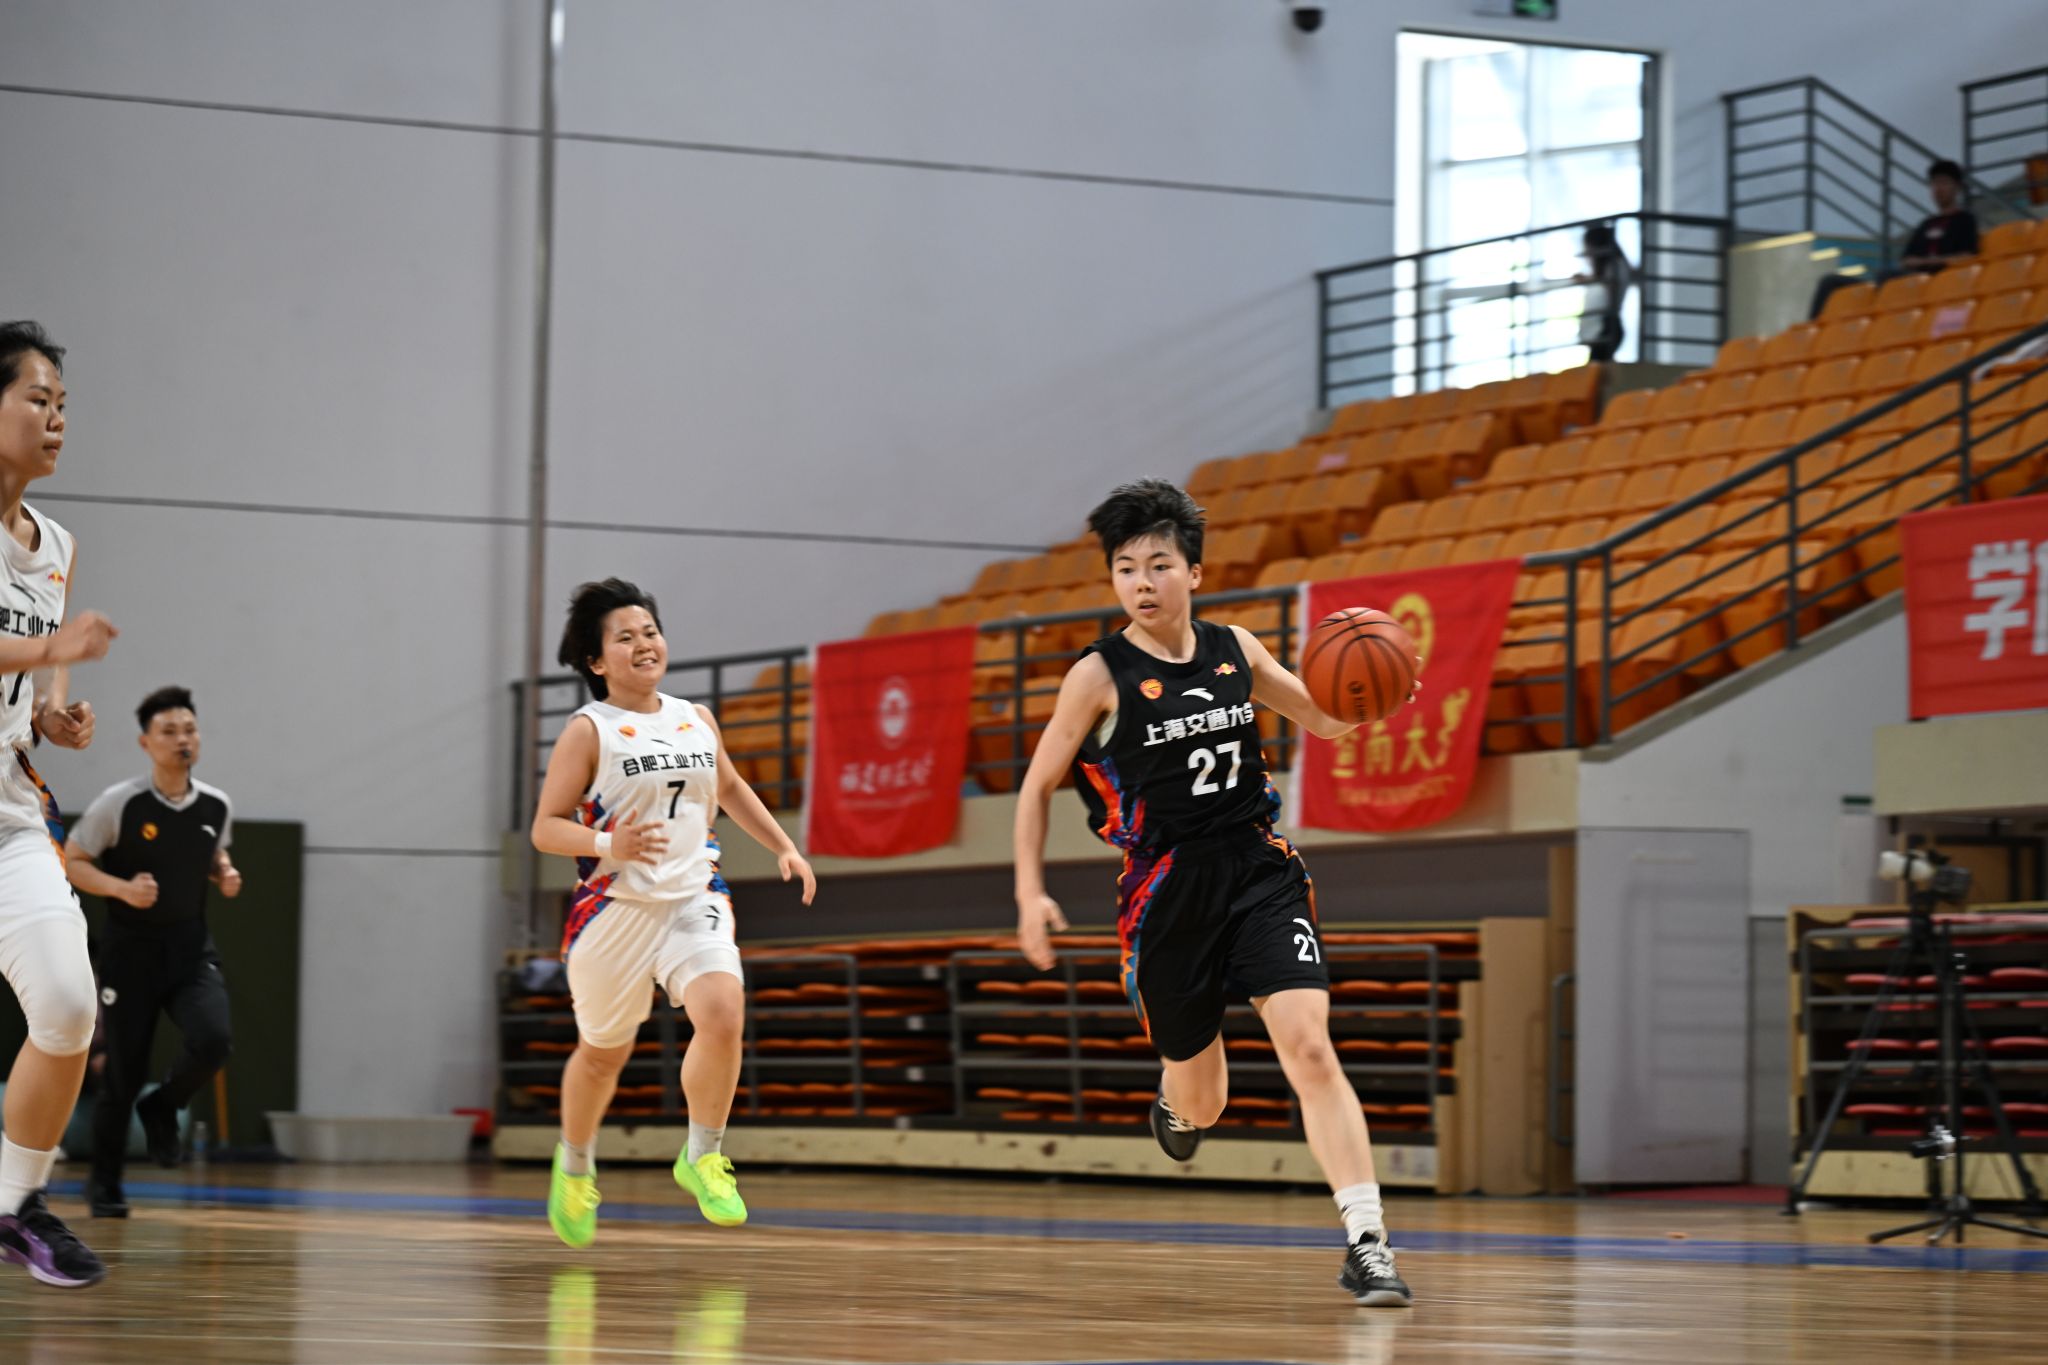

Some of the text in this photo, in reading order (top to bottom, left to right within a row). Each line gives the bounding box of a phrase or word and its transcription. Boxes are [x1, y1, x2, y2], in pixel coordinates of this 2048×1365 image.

[1964, 538, 2048, 661] 学
[1187, 740, 1241, 796] 27
[667, 780, 686, 819] 7
[704, 914, 719, 931] 7
